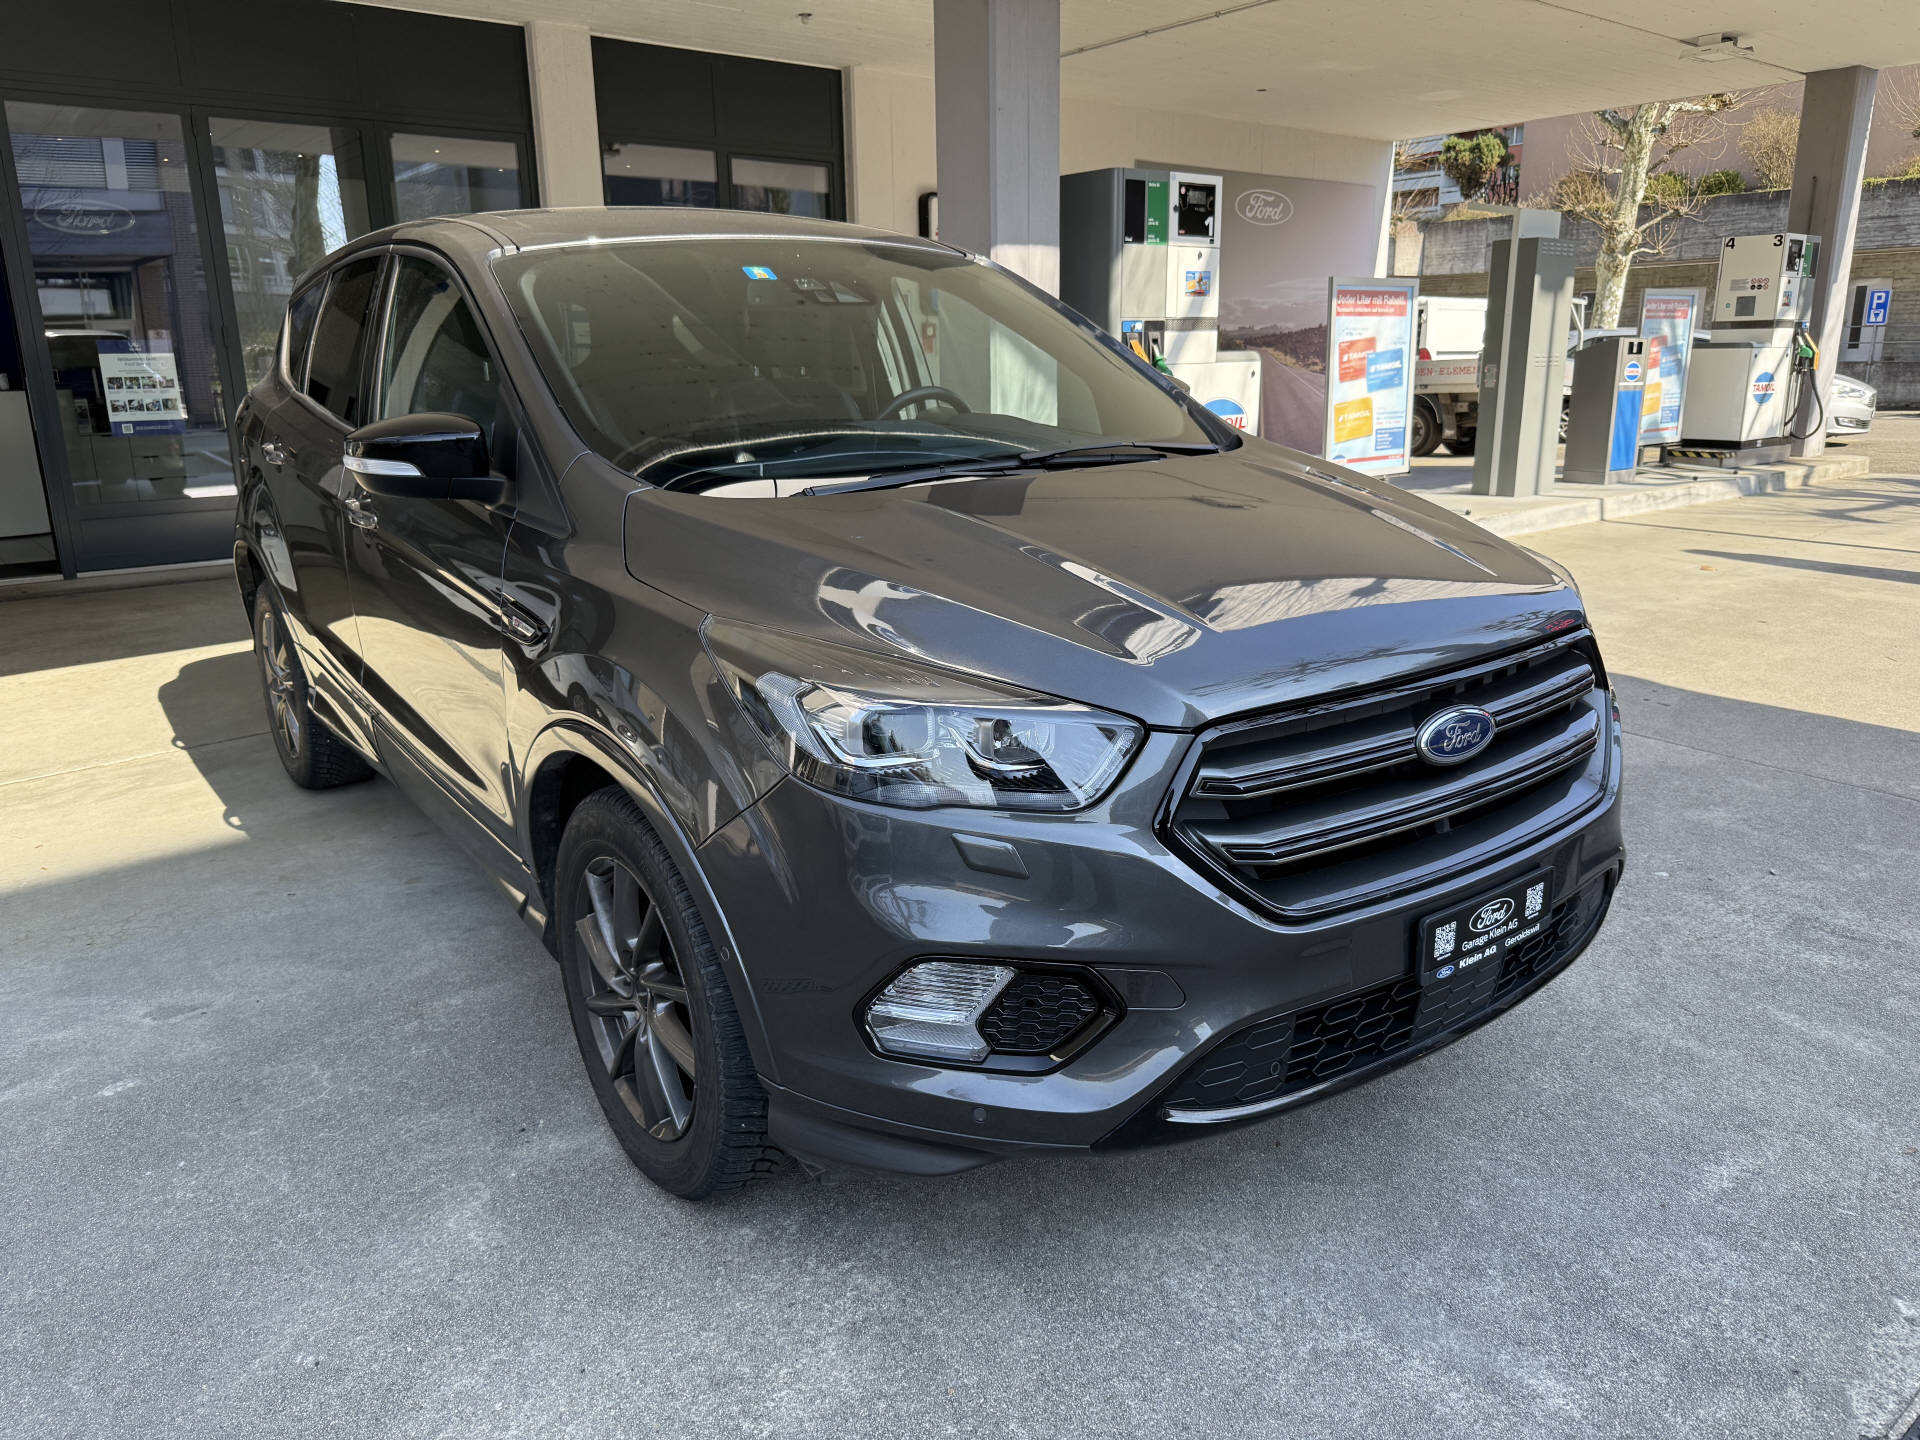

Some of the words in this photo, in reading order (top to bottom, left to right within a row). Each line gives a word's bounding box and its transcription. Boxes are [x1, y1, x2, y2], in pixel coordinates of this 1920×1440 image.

[56, 204, 116, 228] Ford
[1246, 193, 1283, 220] Ford
[1205, 216, 1213, 236] 1
[1726, 237, 1736, 249] 4
[1773, 234, 1784, 247] 3
[1873, 292, 1886, 309] P
[1752, 383, 1775, 392] TAMOIL
[1443, 720, 1482, 752] Ford
[1477, 903, 1508, 929] Ford
[1461, 934, 1489, 951] Garage
[1489, 925, 1507, 940] Klein
[1507, 918, 1519, 931] AG
[1504, 922, 1541, 947] Geroldswil
[1458, 953, 1483, 969] Klein
[1483, 945, 1497, 958] AG
